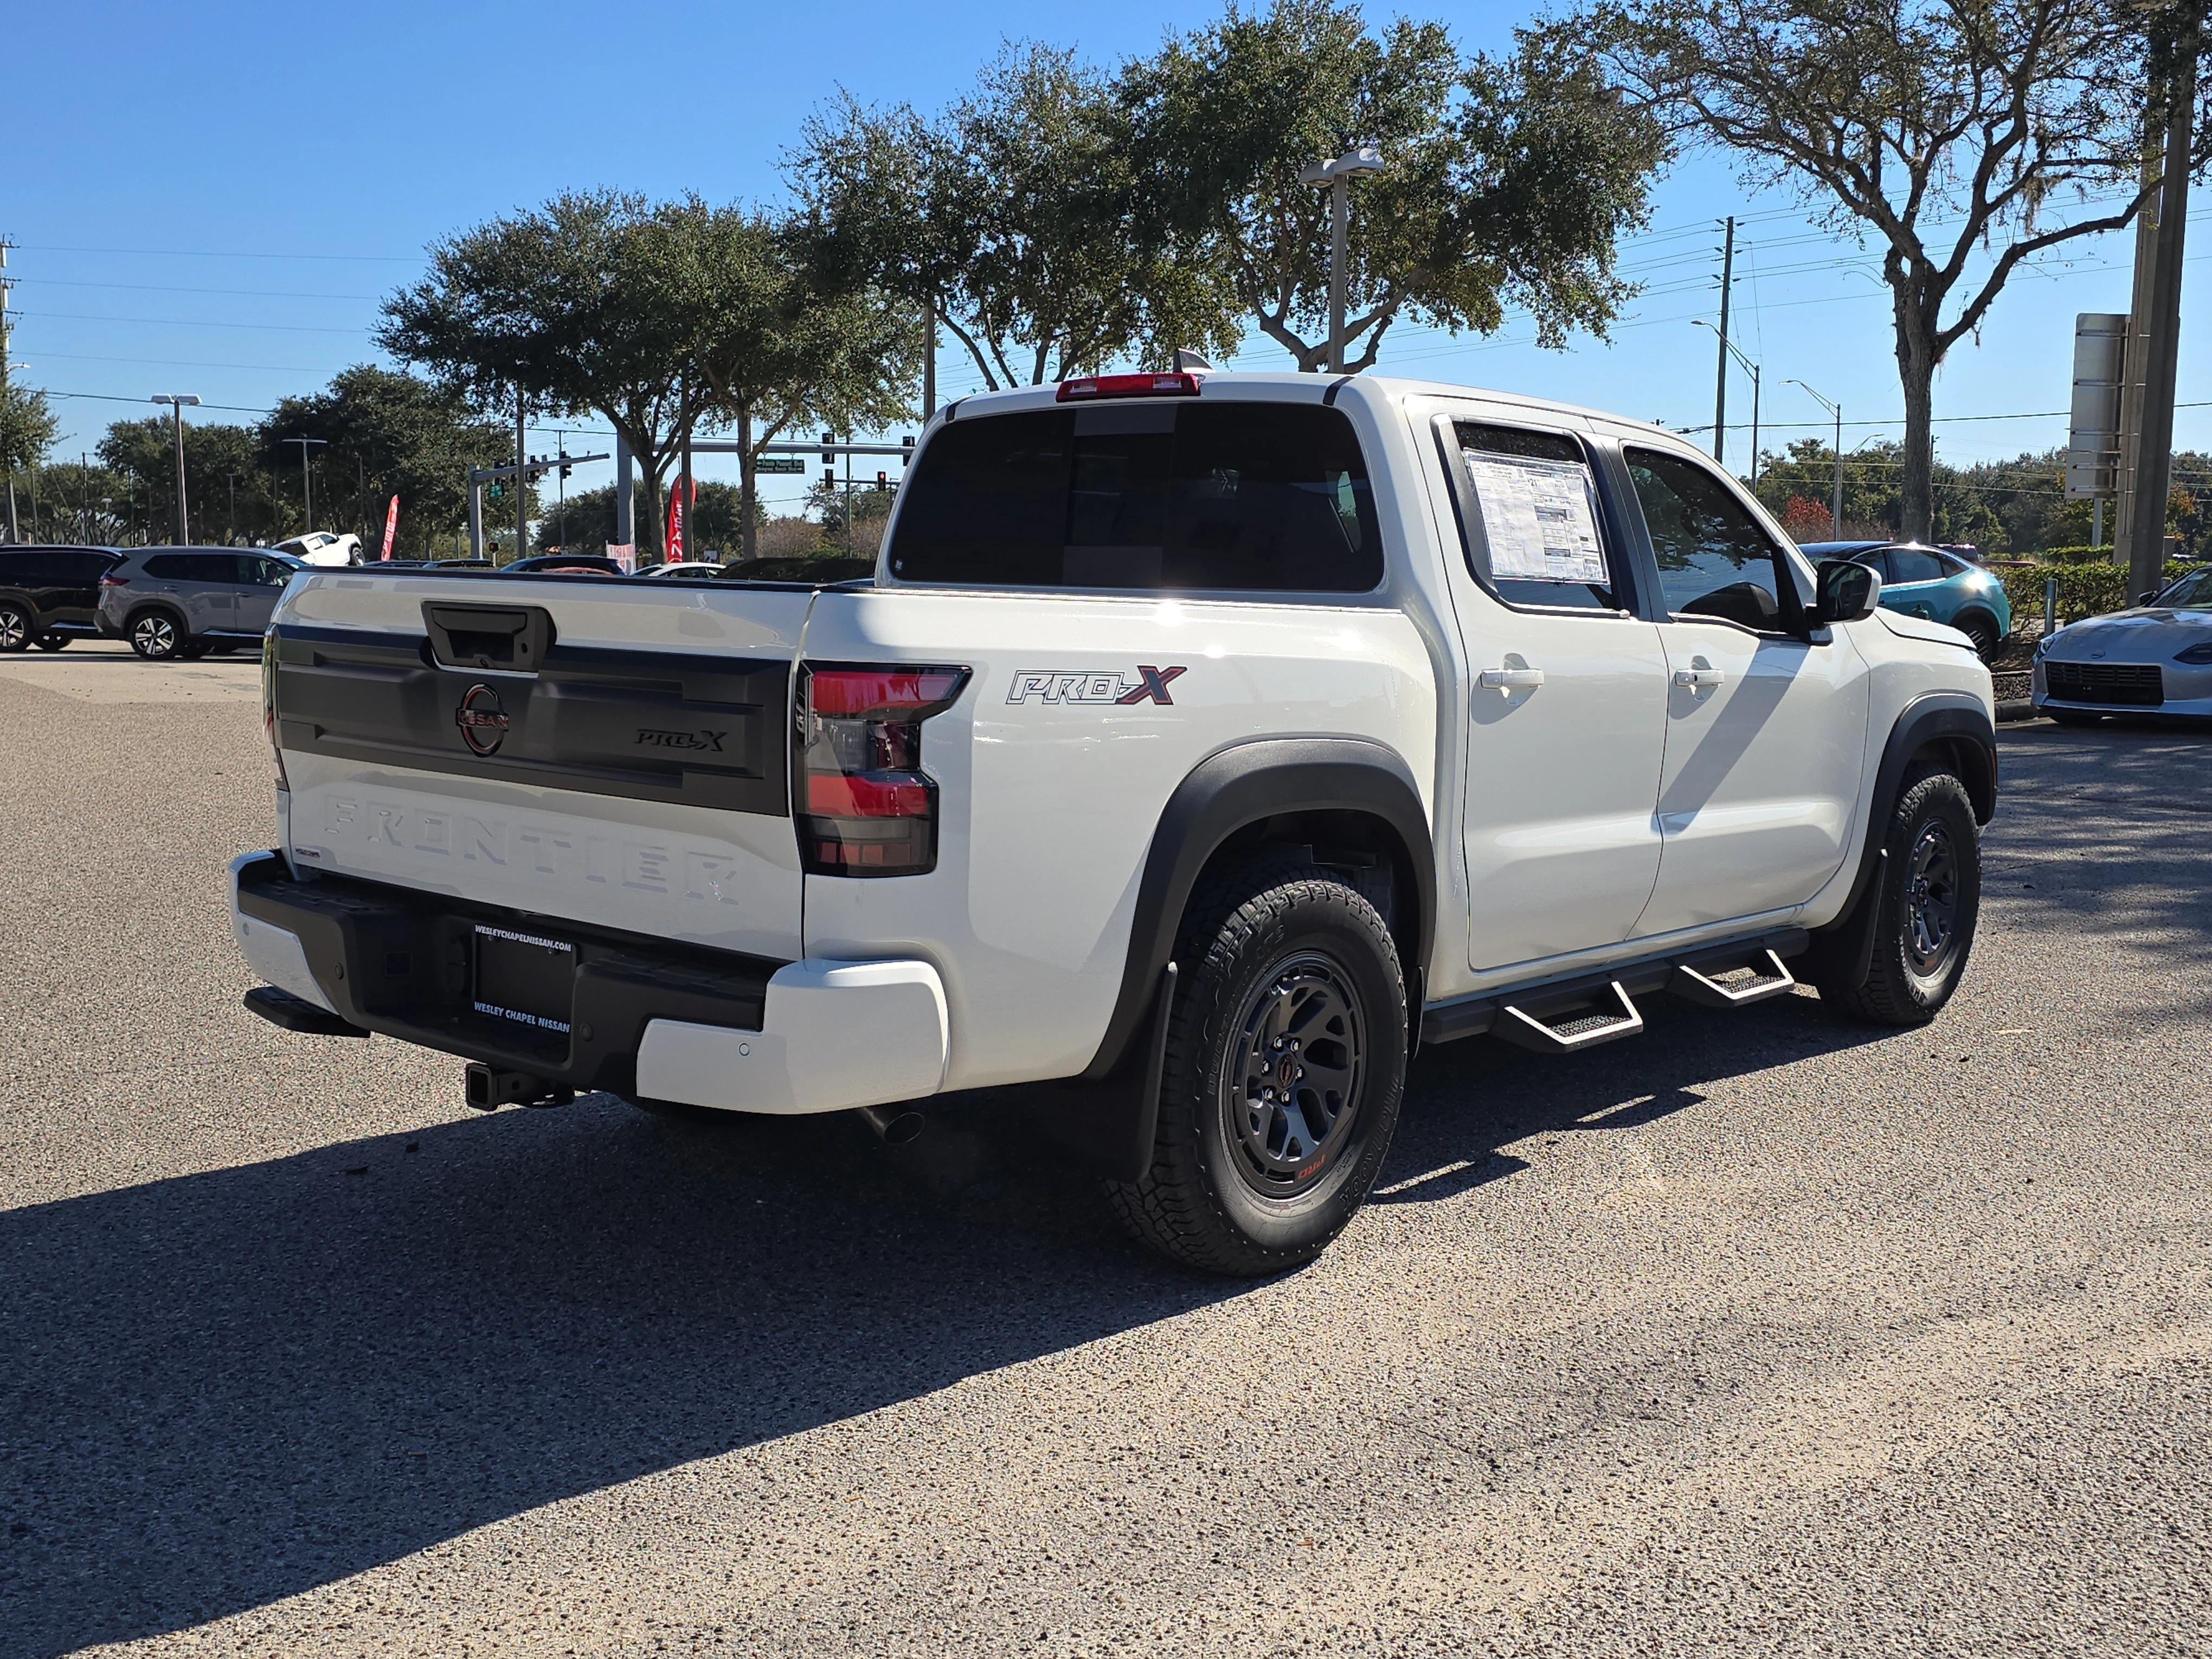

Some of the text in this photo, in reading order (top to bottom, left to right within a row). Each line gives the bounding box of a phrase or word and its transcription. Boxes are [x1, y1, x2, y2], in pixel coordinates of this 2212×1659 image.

[1006, 664, 1188, 705] PRO-X
[634, 729, 728, 752] PRO-X
[325, 794, 739, 906] FRONTIER
[475, 924, 571, 952] WESLEYCHAPELNISSAN.COM
[474, 1001, 570, 1033] WESLEY CHAPEL NISSAN
